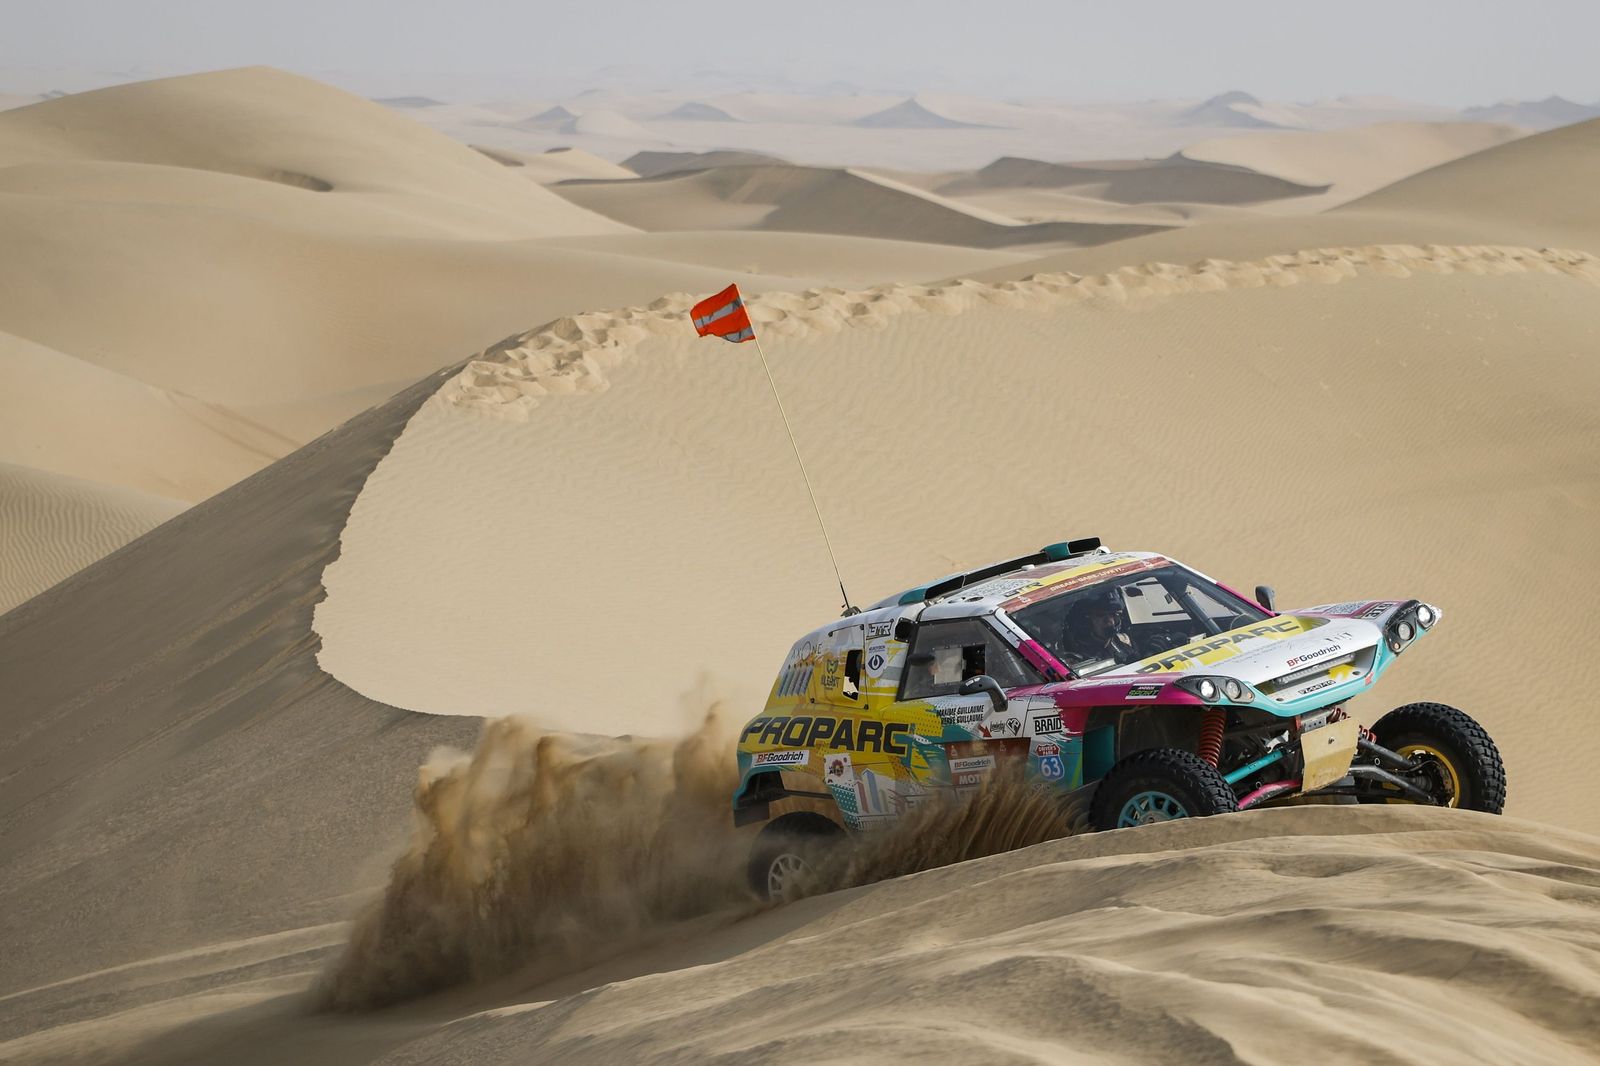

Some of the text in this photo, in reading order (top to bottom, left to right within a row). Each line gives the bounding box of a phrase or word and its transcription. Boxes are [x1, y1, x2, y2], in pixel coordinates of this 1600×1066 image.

[1136, 621, 1299, 674] PROPARC
[1287, 644, 1341, 667] BFGoodrich
[957, 705, 984, 715] GUILLAUME
[1034, 718, 1061, 732] BRAID
[739, 716, 909, 755] PROPARC
[756, 751, 804, 763] BFGoodrich
[954, 758, 990, 768] BFGoodrich
[1041, 757, 1060, 777] 63
